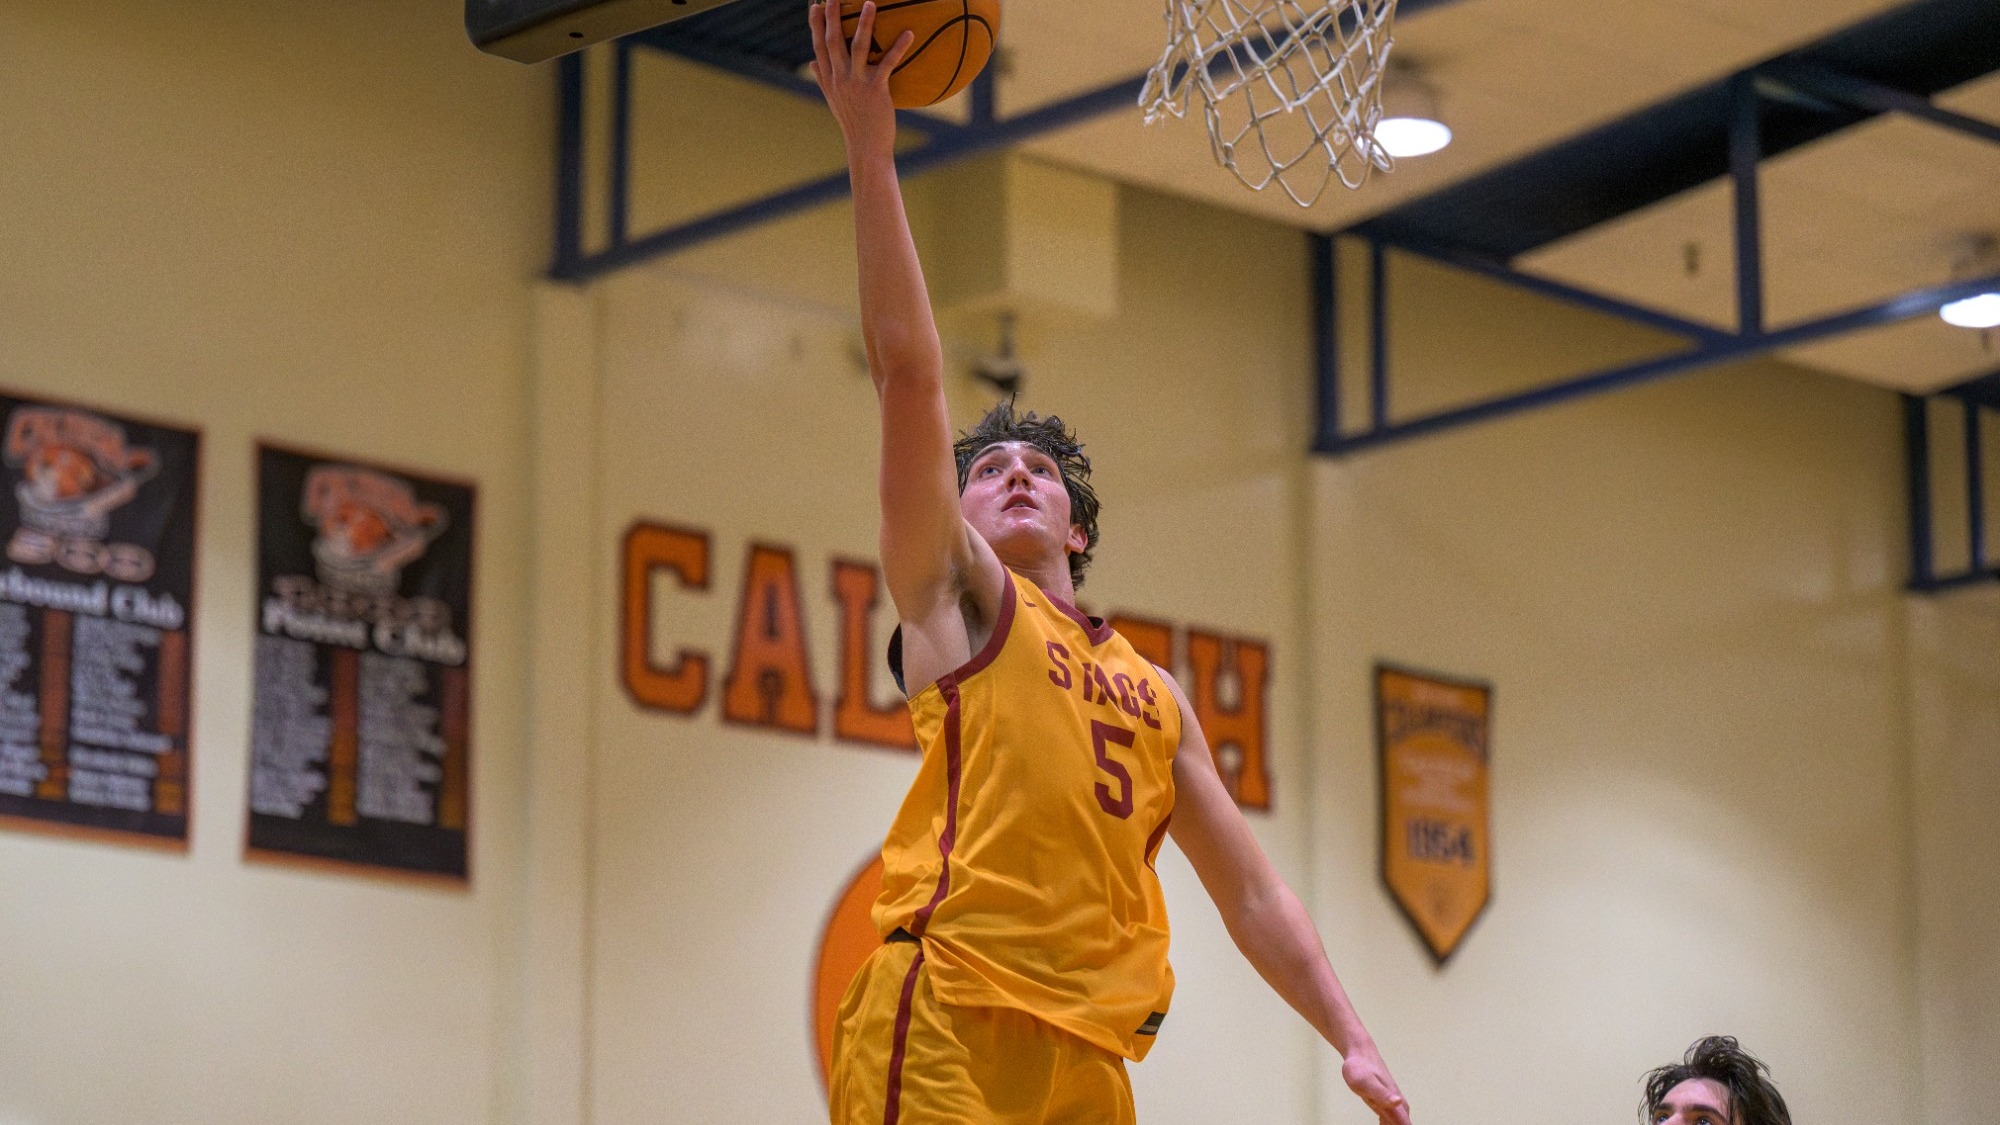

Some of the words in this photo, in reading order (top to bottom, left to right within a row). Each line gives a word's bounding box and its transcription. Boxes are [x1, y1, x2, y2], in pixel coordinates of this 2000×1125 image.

[110, 584, 185, 629] Club
[372, 617, 466, 667] Club
[620, 520, 1272, 815] CALH
[1046, 640, 1162, 730] STAGS
[1090, 718, 1136, 820] 5
